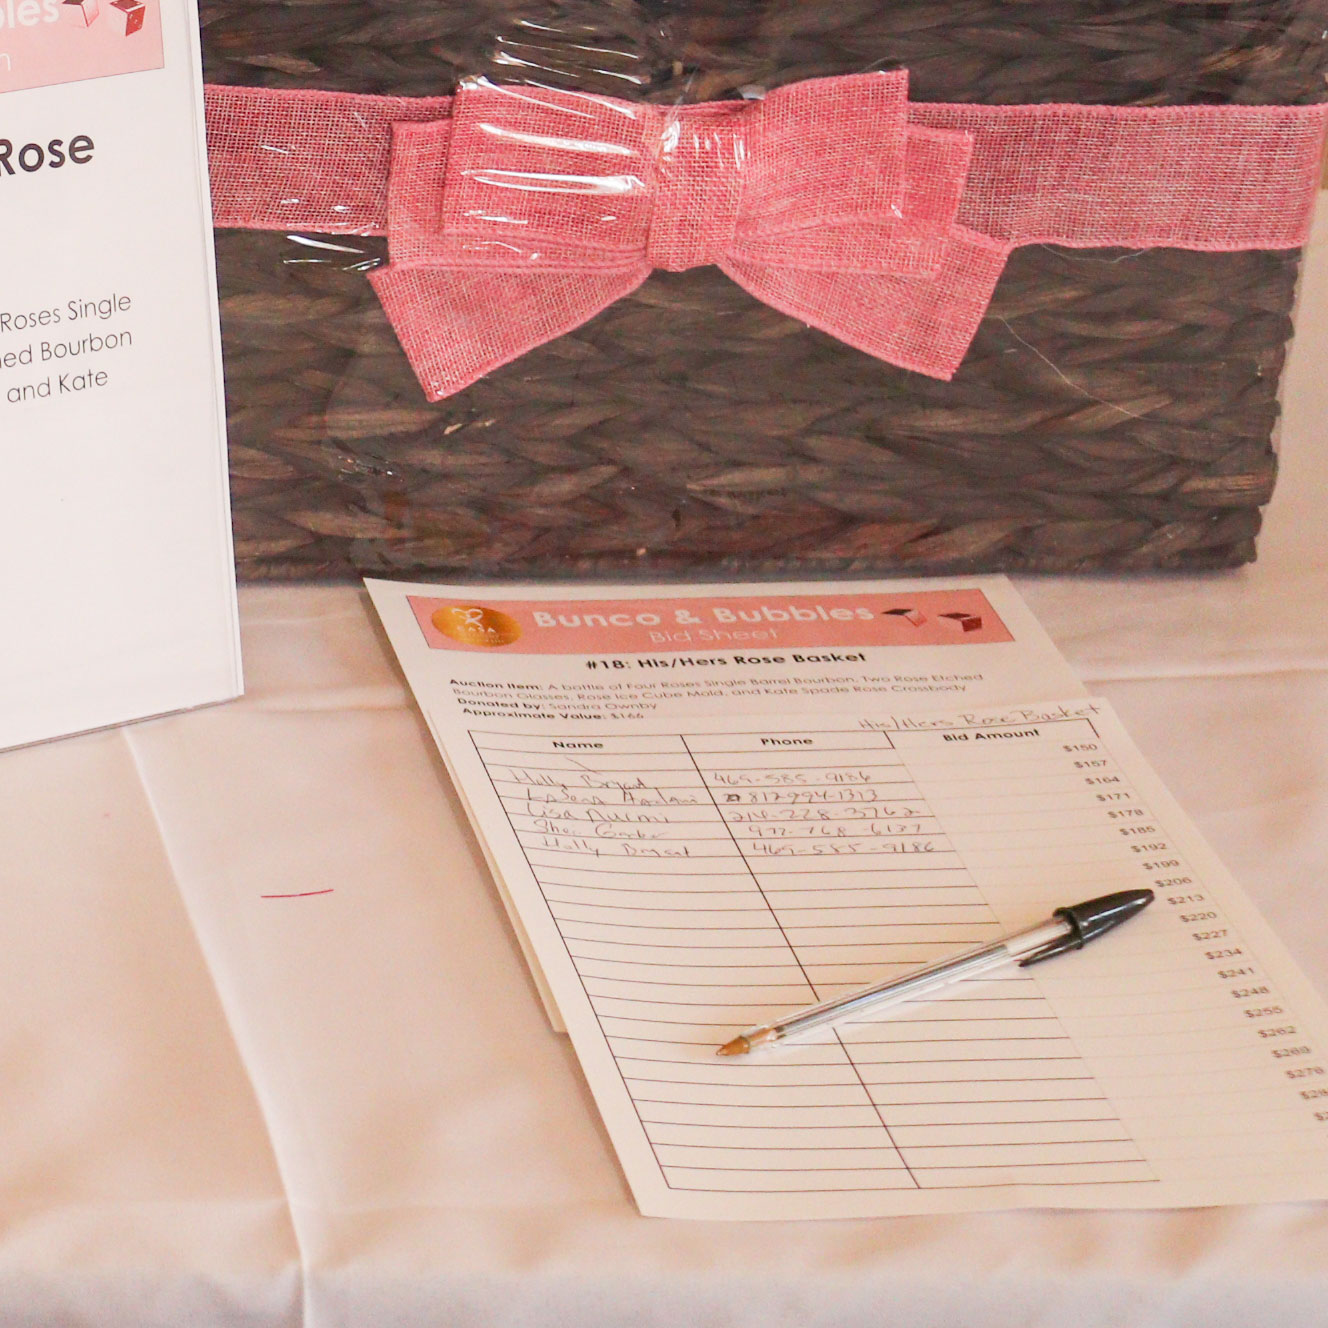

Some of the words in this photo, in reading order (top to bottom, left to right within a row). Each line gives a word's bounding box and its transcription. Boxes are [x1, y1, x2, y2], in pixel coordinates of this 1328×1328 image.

[0, 305, 61, 333] Roses
[67, 292, 132, 324] Single
[41, 329, 132, 361] Bourbon
[7, 378, 51, 404] and
[58, 369, 108, 393] Kate
[533, 611, 658, 628] Bunco
[676, 608, 701, 624] &
[714, 604, 875, 624] Bubbles
[650, 630, 691, 643] Bid
[699, 627, 777, 642] Sheet
[585, 658, 630, 670] #18:
[638, 655, 728, 669] His/Hers
[734, 653, 785, 665] Rose
[793, 651, 866, 664] Basket
[553, 740, 604, 750] Name
[761, 737, 813, 747] Phone
[943, 733, 968, 742] Bid
[976, 728, 1040, 740] Amount
[1063, 743, 1098, 753] $150
[1155, 877, 1193, 888] $206
[1179, 911, 1217, 923] $220
[1205, 948, 1243, 960] $234
